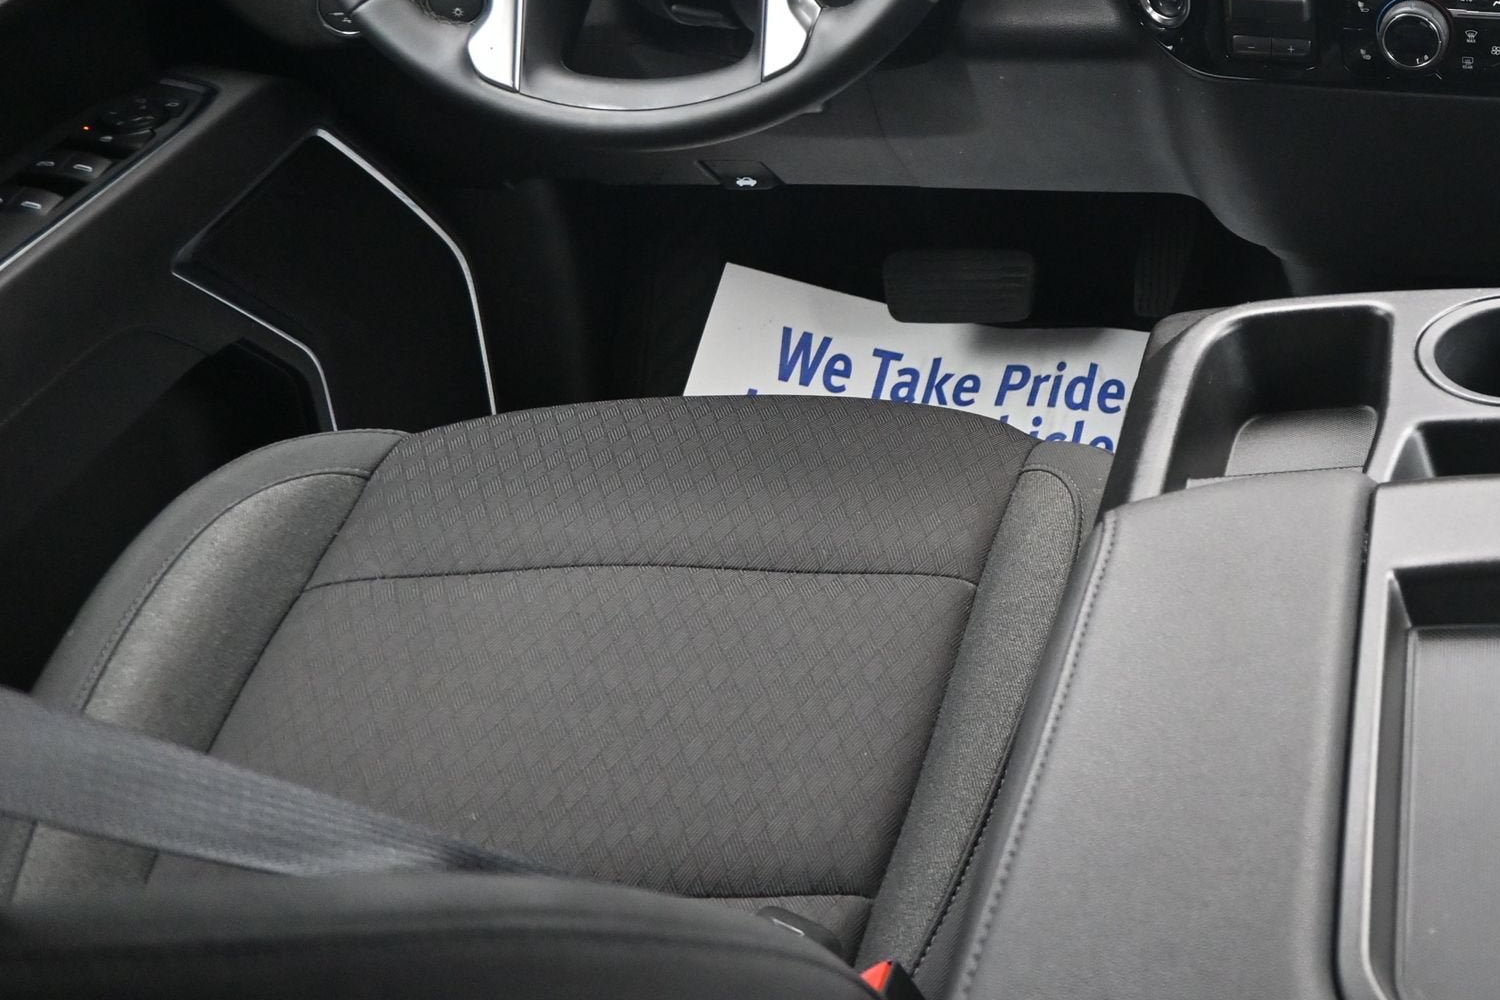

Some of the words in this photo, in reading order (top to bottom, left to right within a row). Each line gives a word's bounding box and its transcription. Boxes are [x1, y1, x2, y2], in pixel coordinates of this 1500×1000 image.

[778, 326, 853, 394] We
[872, 347, 981, 407] Take
[994, 361, 1126, 414] Pride
